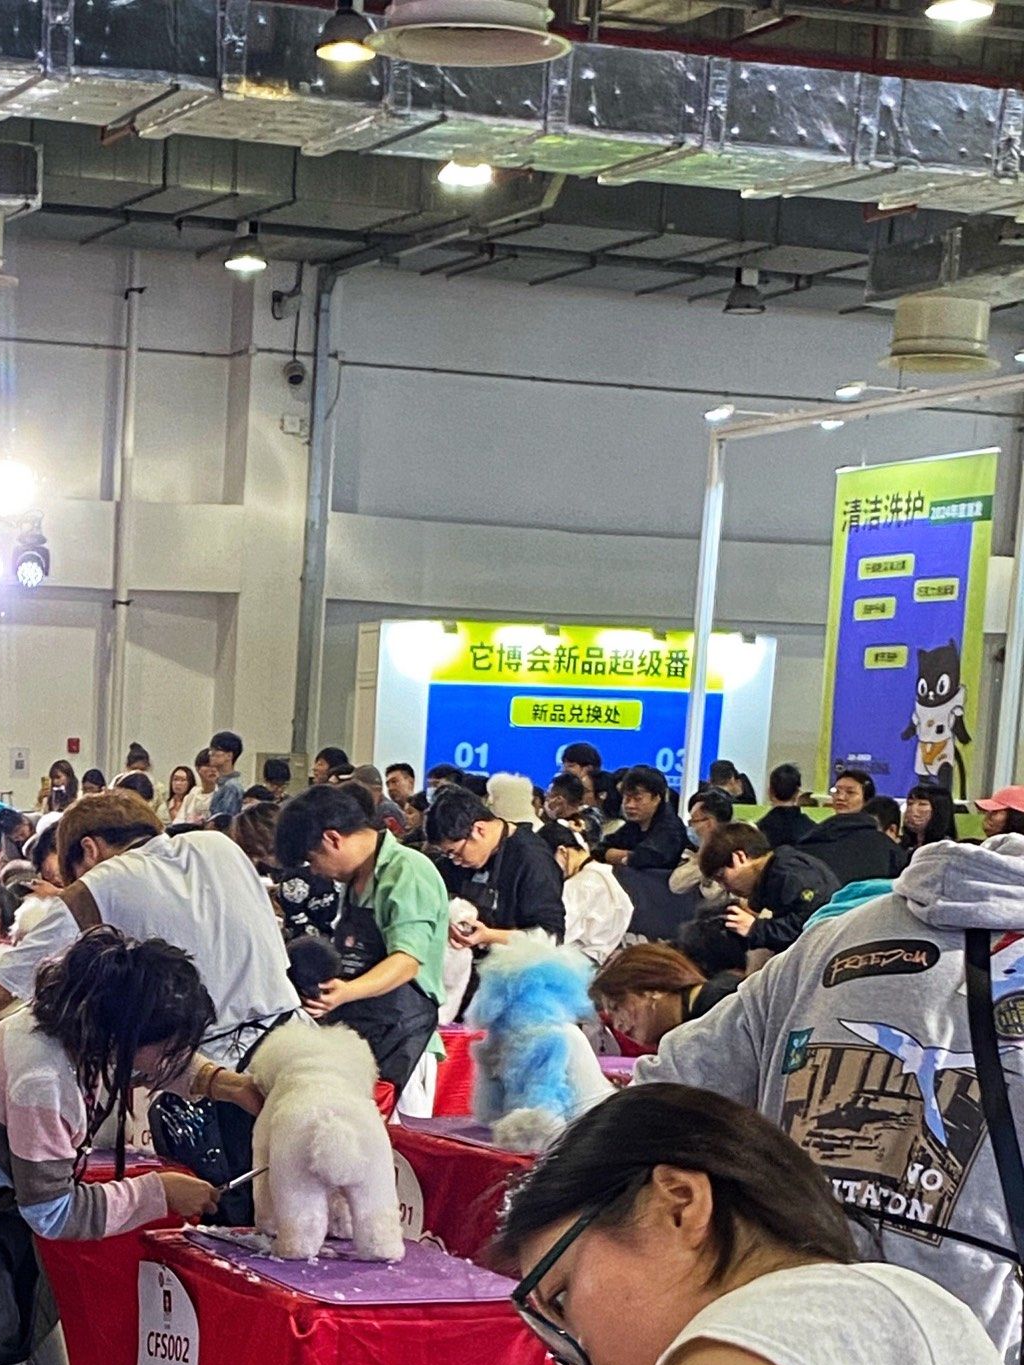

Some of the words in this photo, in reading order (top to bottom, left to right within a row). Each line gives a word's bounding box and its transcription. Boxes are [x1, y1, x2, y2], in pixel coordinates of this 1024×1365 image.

[842, 490, 924, 534] 清洁洗护
[470, 641, 690, 679] 它博会新品超级番
[532, 703, 621, 724] 新品兑换处
[454, 741, 489, 768] 01
[147, 1331, 190, 1363] CFS002
